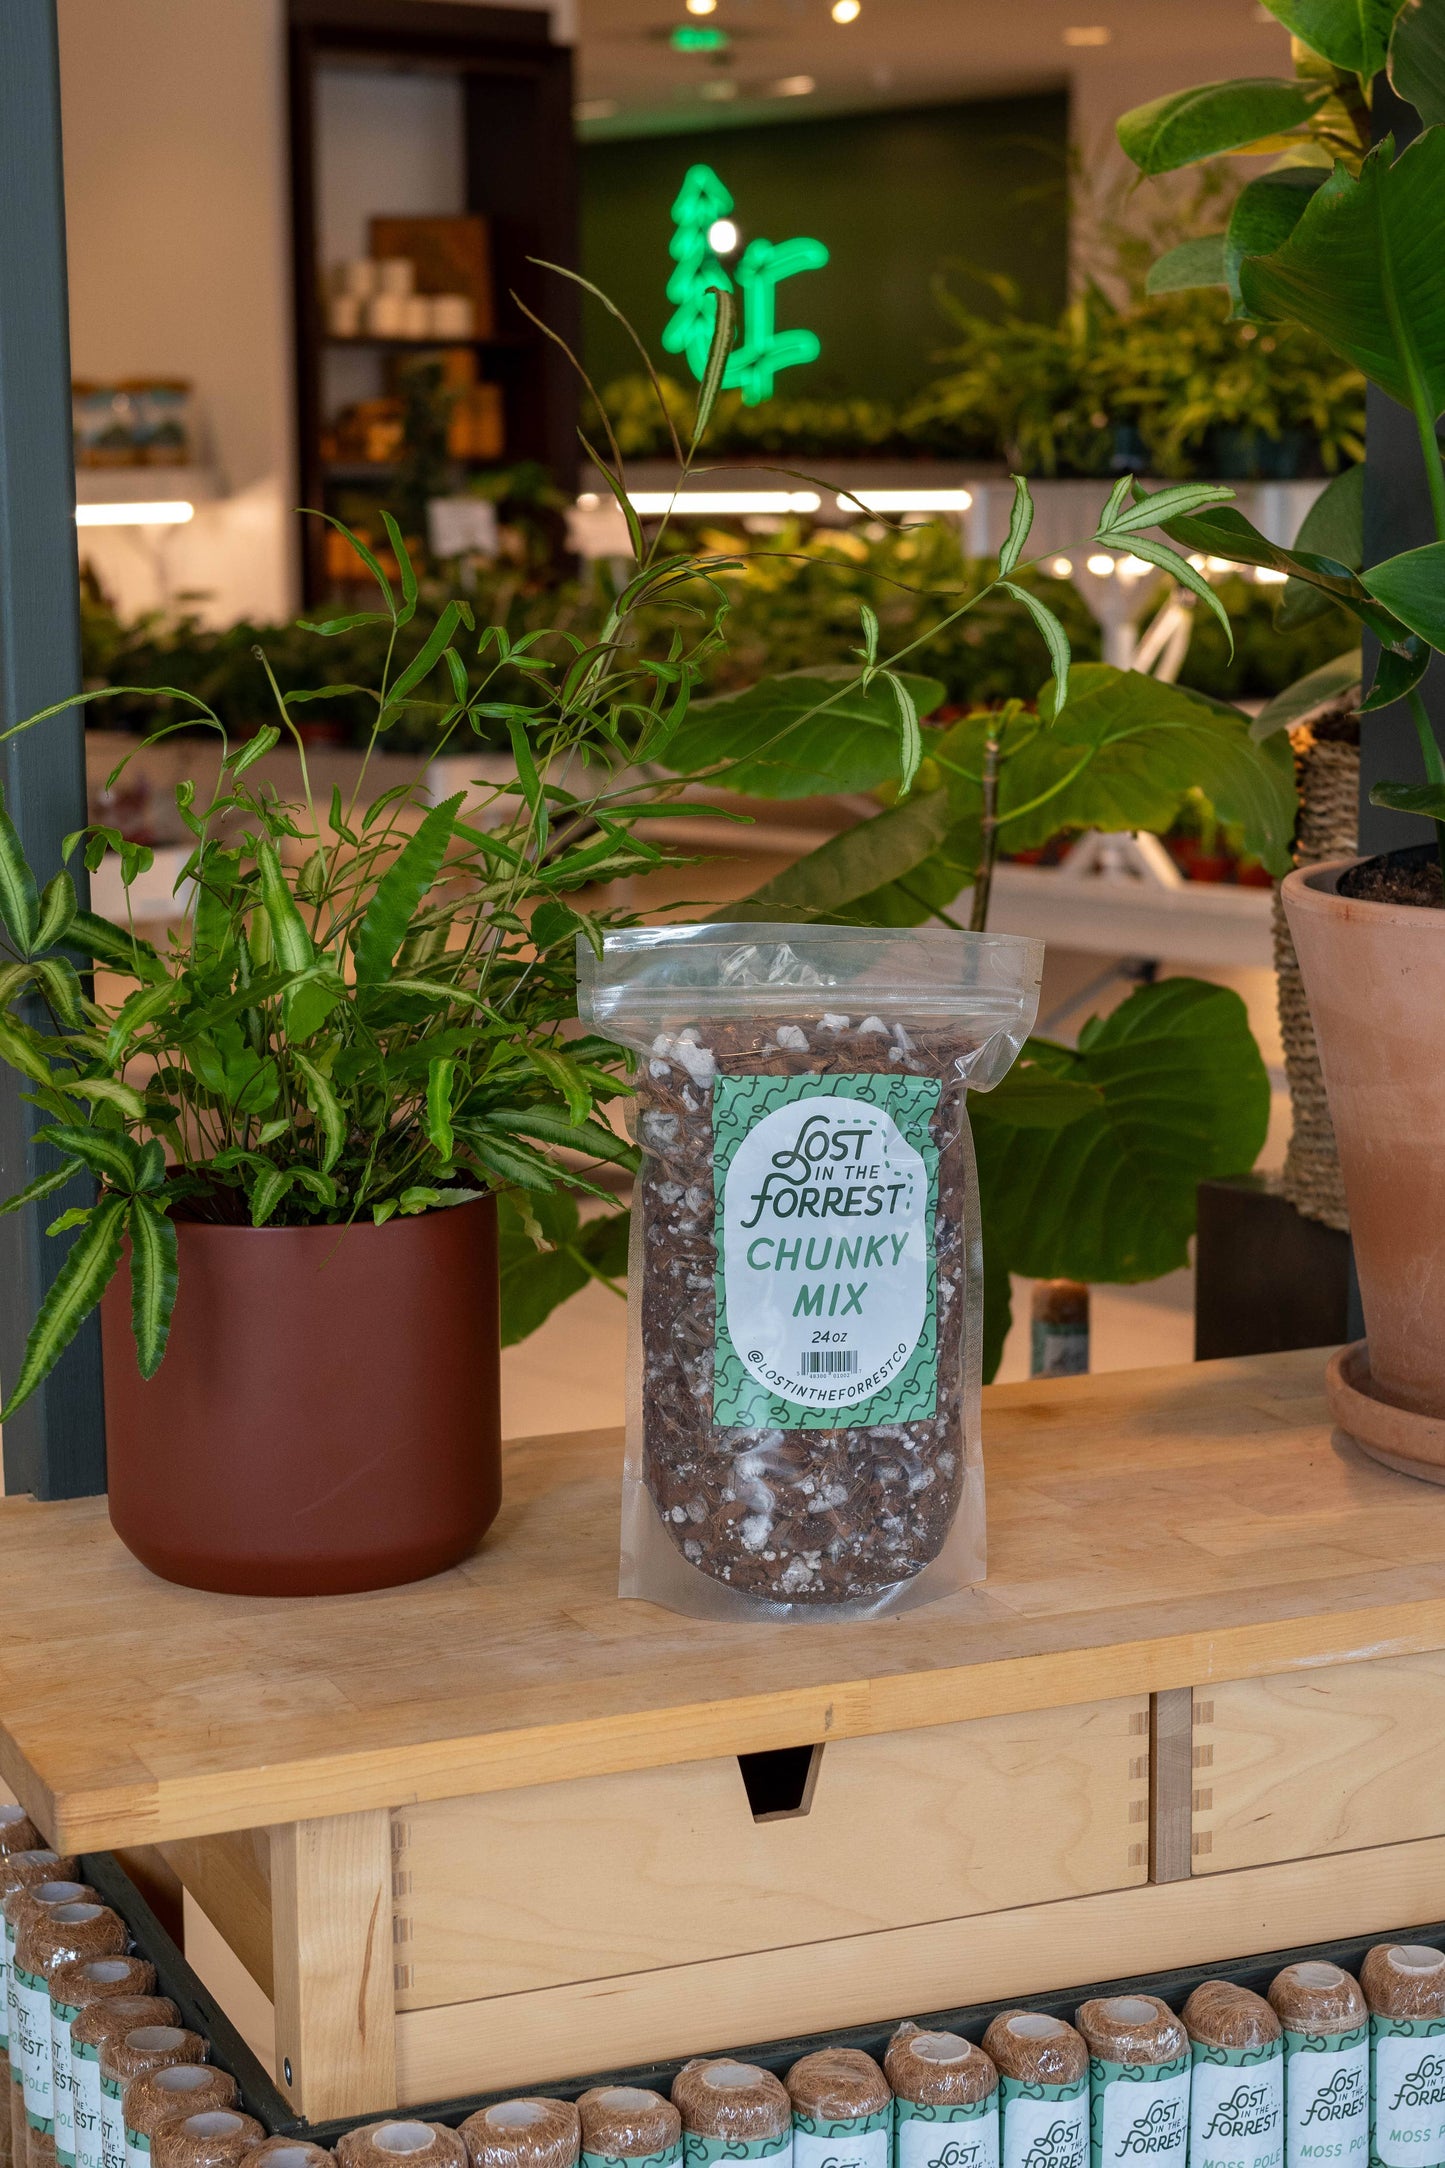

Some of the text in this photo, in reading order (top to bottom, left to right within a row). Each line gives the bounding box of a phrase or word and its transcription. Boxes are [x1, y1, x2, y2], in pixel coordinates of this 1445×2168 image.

[772, 1115, 872, 1170] LOST
[815, 1165, 880, 1180] IN THE
[746, 1231, 909, 1272] CHUNKY
[792, 1282, 868, 1317] MIX
[747, 1342, 908, 1401] @LOSTINTHEFORRESTCO
[1405, 2055, 1445, 2083] LOS
[25, 2073, 50, 2094] POLE
[1317, 2069, 1362, 2097] LOST
[1339, 2085, 1364, 2101] IN THE
[1427, 2078, 1437, 2088] IN
[1218, 2085, 1267, 2112] LOST
[1133, 2099, 1180, 2129] LOST
[1240, 2104, 1270, 2118] IN THE
[1034, 2120, 1081, 2147] LOST
[1155, 2119, 1181, 2133] IN THE
[1389, 2128, 1431, 2143] MOSS
[1056, 2145, 1066, 2153] IN
[1300, 2144, 1342, 2158] MOSS
